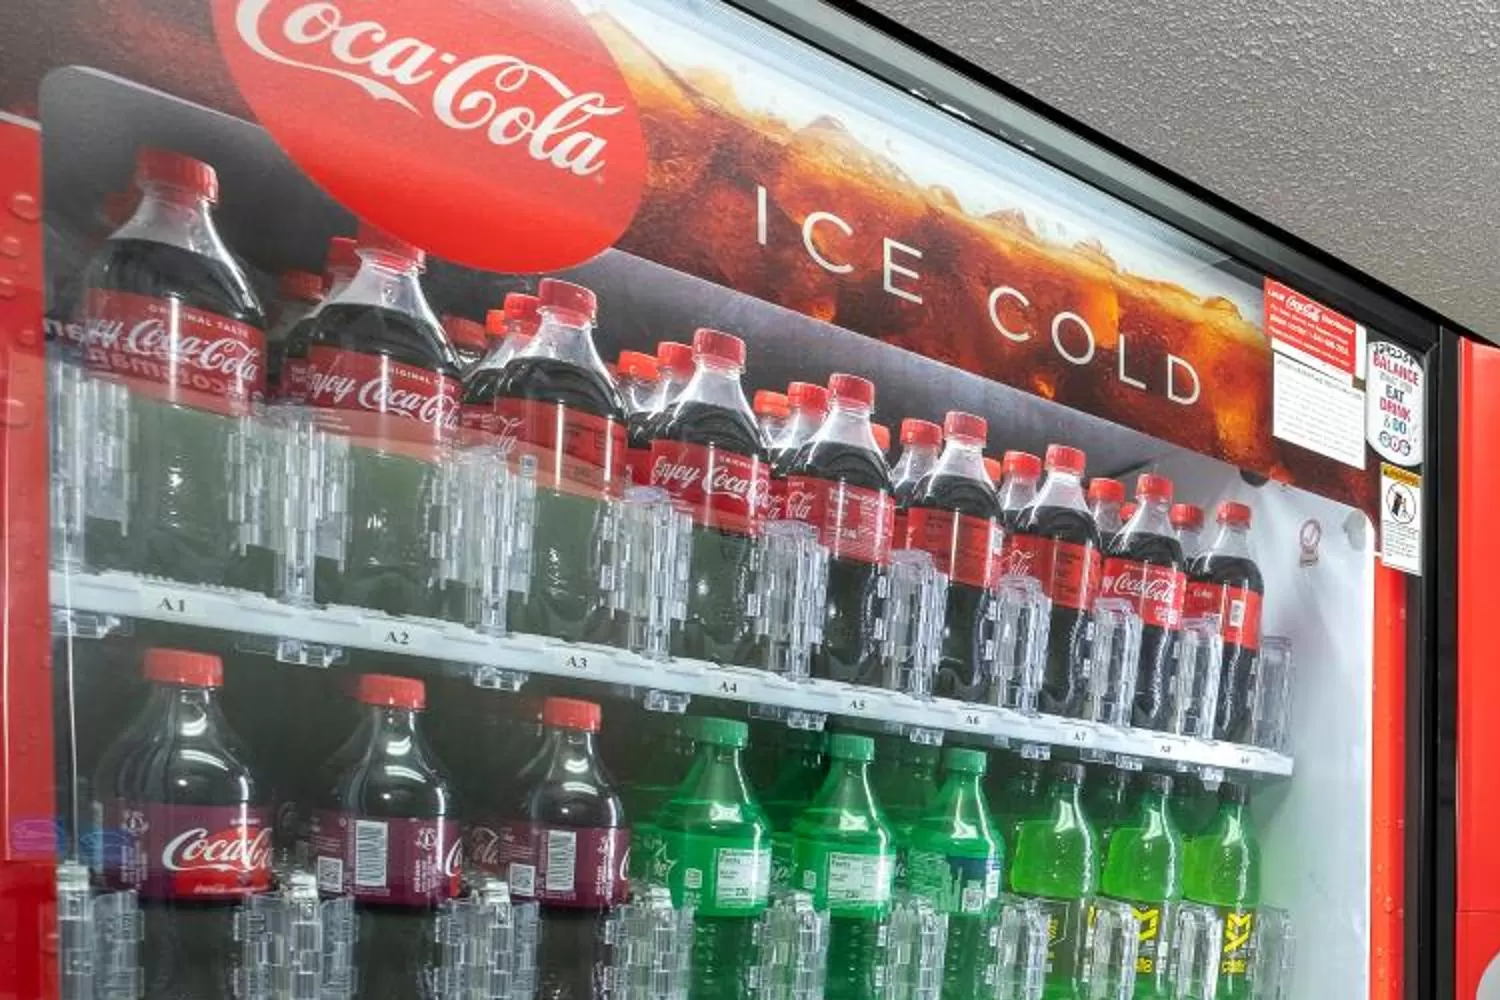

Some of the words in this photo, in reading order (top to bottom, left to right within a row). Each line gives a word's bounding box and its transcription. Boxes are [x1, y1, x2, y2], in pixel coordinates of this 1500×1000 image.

[236, 0, 624, 177] Coca-Cola
[756, 186, 924, 304] ICE
[987, 286, 1201, 405] COLD
[149, 304, 211, 327] ORINAL
[128, 318, 258, 381] Coca-Cola
[157, 597, 185, 612] A1
[383, 631, 409, 645] A2
[565, 655, 588, 668] A3
[719, 681, 738, 694] A4
